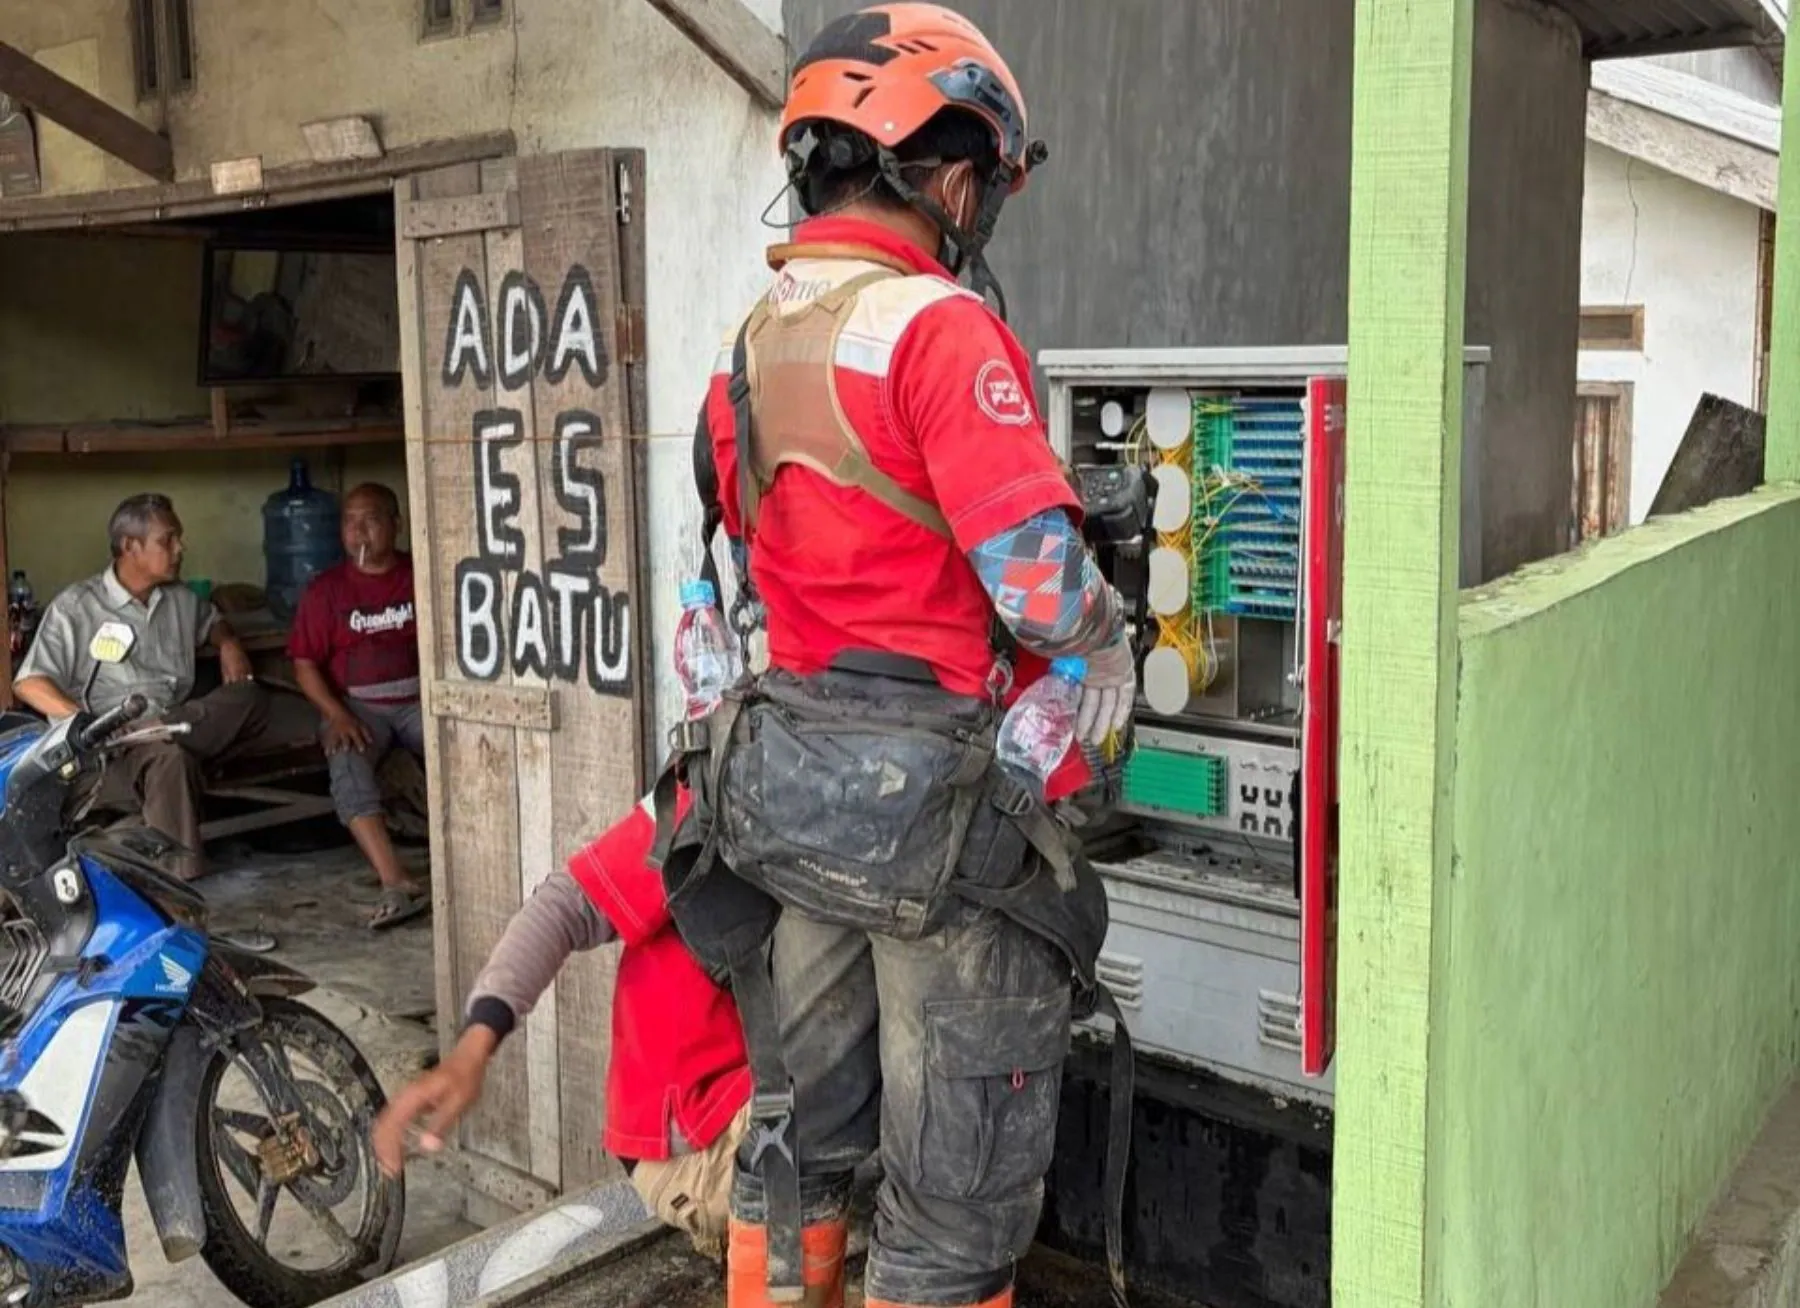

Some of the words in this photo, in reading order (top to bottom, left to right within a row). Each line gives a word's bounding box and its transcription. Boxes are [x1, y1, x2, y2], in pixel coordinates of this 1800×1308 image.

[443, 265, 607, 389] ADA
[473, 408, 606, 570] ES
[456, 557, 632, 694] BATU
